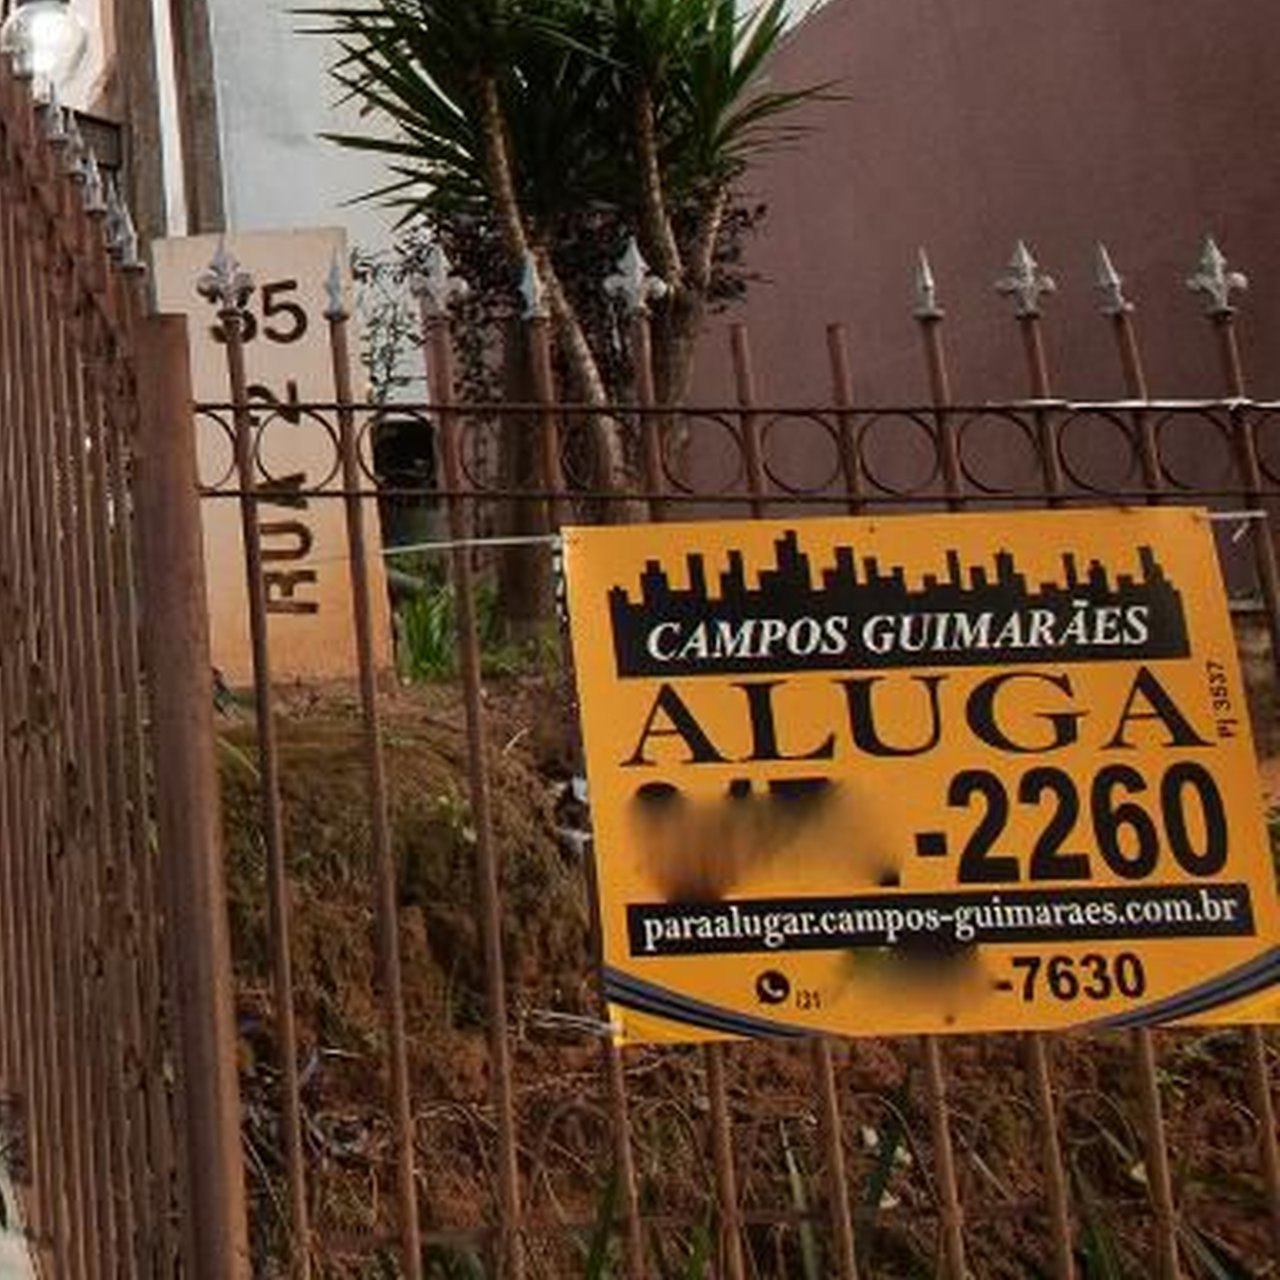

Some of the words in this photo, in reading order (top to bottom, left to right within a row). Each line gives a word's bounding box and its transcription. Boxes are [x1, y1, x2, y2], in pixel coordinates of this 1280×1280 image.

[256, 473, 318, 614] RUA
[646, 616, 847, 662] CAMPOS
[862, 599, 1150, 653] GUIMARÃES
[619, 665, 1217, 768] ALUGA
[642, 892, 1239, 951] paraalugar.campos-guimaraes.com.br
